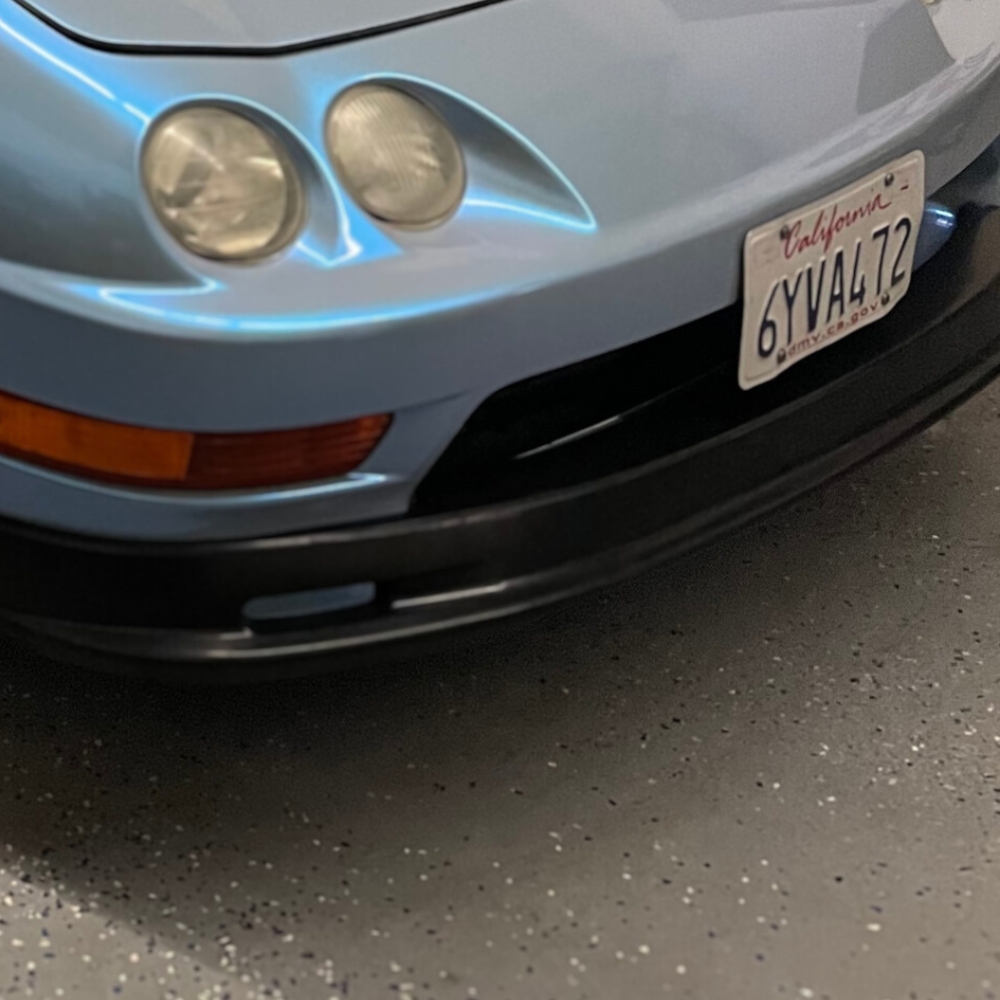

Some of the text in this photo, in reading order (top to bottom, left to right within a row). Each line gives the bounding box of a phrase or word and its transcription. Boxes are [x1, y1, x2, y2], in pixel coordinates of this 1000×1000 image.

[784, 194, 892, 259] California
[757, 216, 912, 358] 6YVA472
[788, 302, 879, 357] dmv.ca.gov
